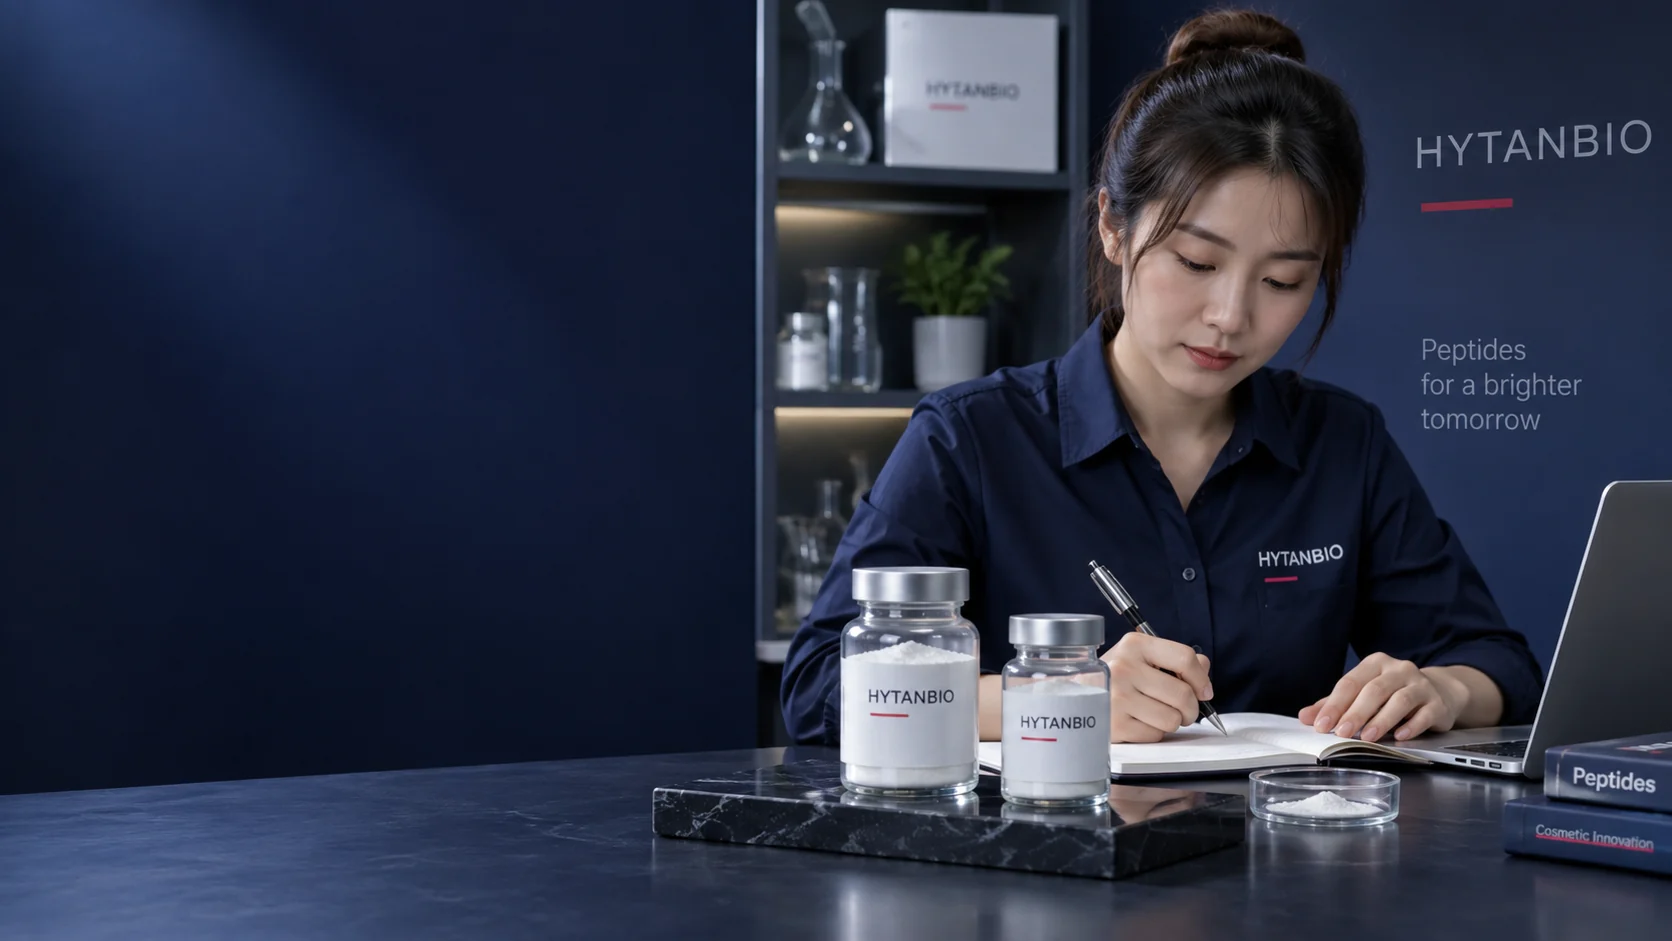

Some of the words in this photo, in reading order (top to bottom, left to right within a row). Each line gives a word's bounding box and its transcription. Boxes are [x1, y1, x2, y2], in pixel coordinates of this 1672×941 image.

[925, 80, 1020, 101] HYTANBIO
[1416, 119, 1652, 169] HYTANBIO
[1421, 338, 1527, 366] Peptides
[1420, 372, 1455, 396] for
[1462, 378, 1476, 396] a
[1484, 372, 1583, 402] brighter
[1420, 408, 1541, 431] tomorrow
[1258, 543, 1344, 568] HYTANBIO
[868, 688, 955, 705] HYTANBIO
[1020, 715, 1097, 730] HYTANBIO
[1573, 766, 1657, 794] Peptides
[1535, 823, 1590, 842] Cosmetic
[1592, 830, 1655, 850] Innovation
